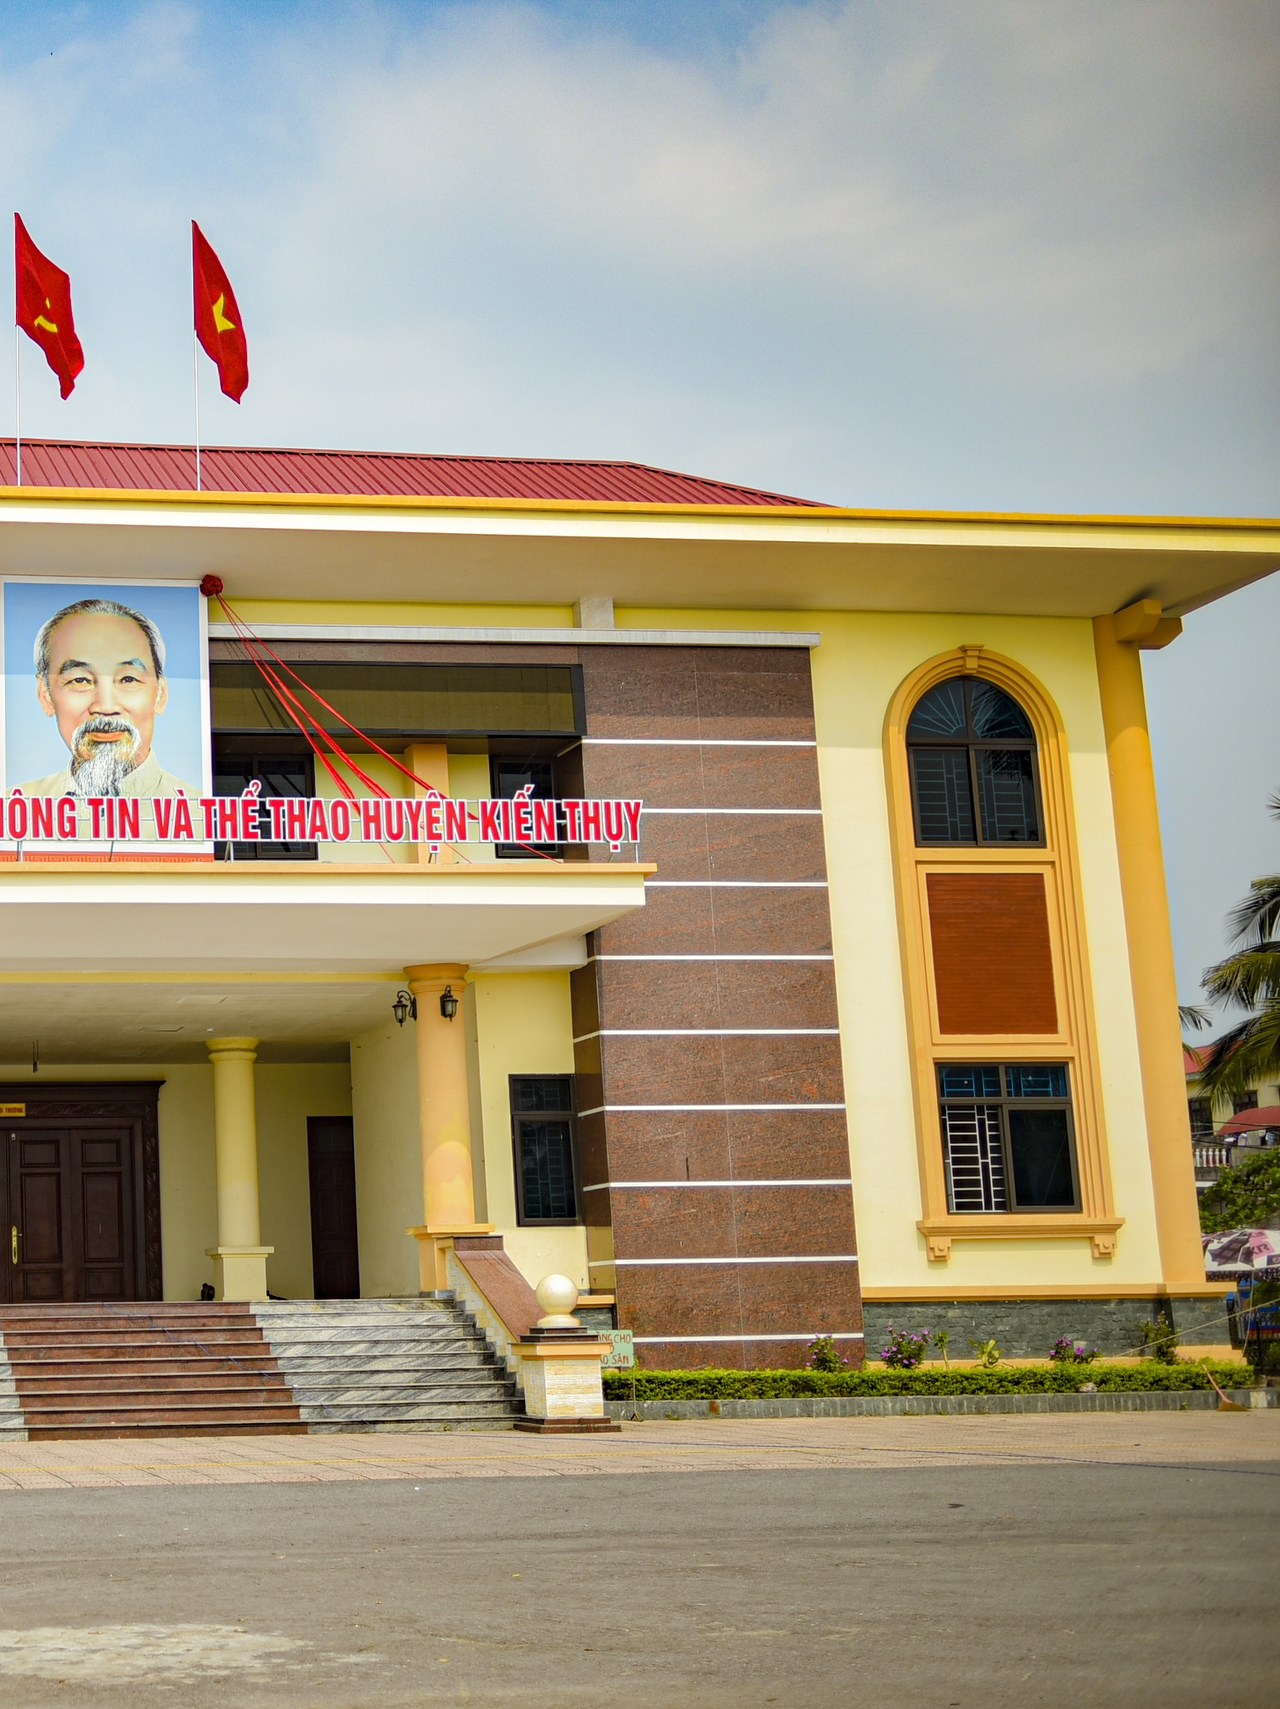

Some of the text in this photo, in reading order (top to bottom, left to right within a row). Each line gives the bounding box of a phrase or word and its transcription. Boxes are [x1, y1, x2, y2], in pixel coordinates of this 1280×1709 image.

[86, 797, 141, 840] TIN
[152, 787, 195, 840] VÀ
[199, 780, 261, 841] THỂ
[268, 797, 351, 842] THAO
[361, 790, 468, 853] HUYỆN
[479, 784, 557, 842] KIẾN
[563, 799, 642, 852] THỤY
[614, 1333, 631, 1344] CHO
[612, 1352, 629, 1365] SÂN
